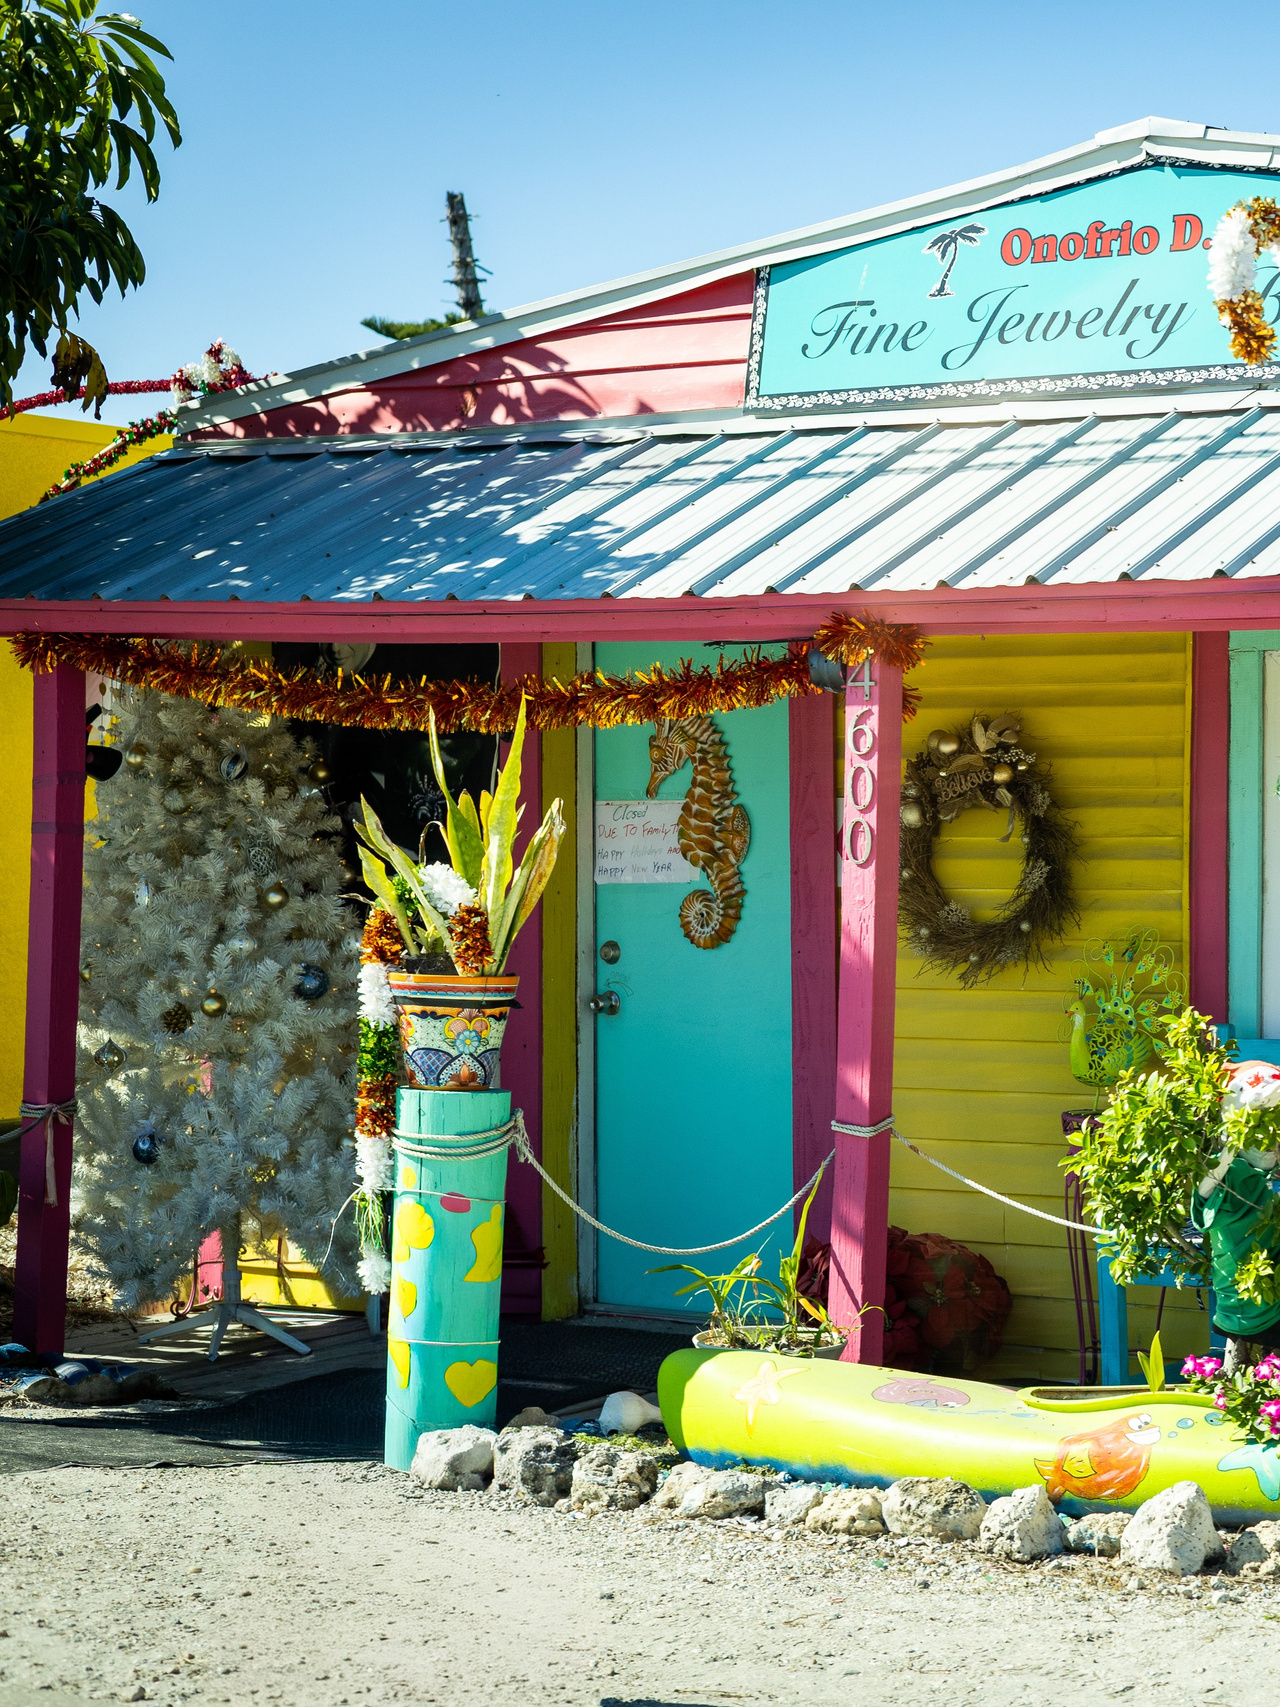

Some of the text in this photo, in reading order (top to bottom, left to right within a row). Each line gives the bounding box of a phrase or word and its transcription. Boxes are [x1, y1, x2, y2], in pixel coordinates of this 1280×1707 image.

[1000, 214, 1212, 267] Onofrio D.
[801, 300, 936, 360] Fine
[940, 278, 1198, 371] Jewelry
[612, 804, 649, 822] Closed
